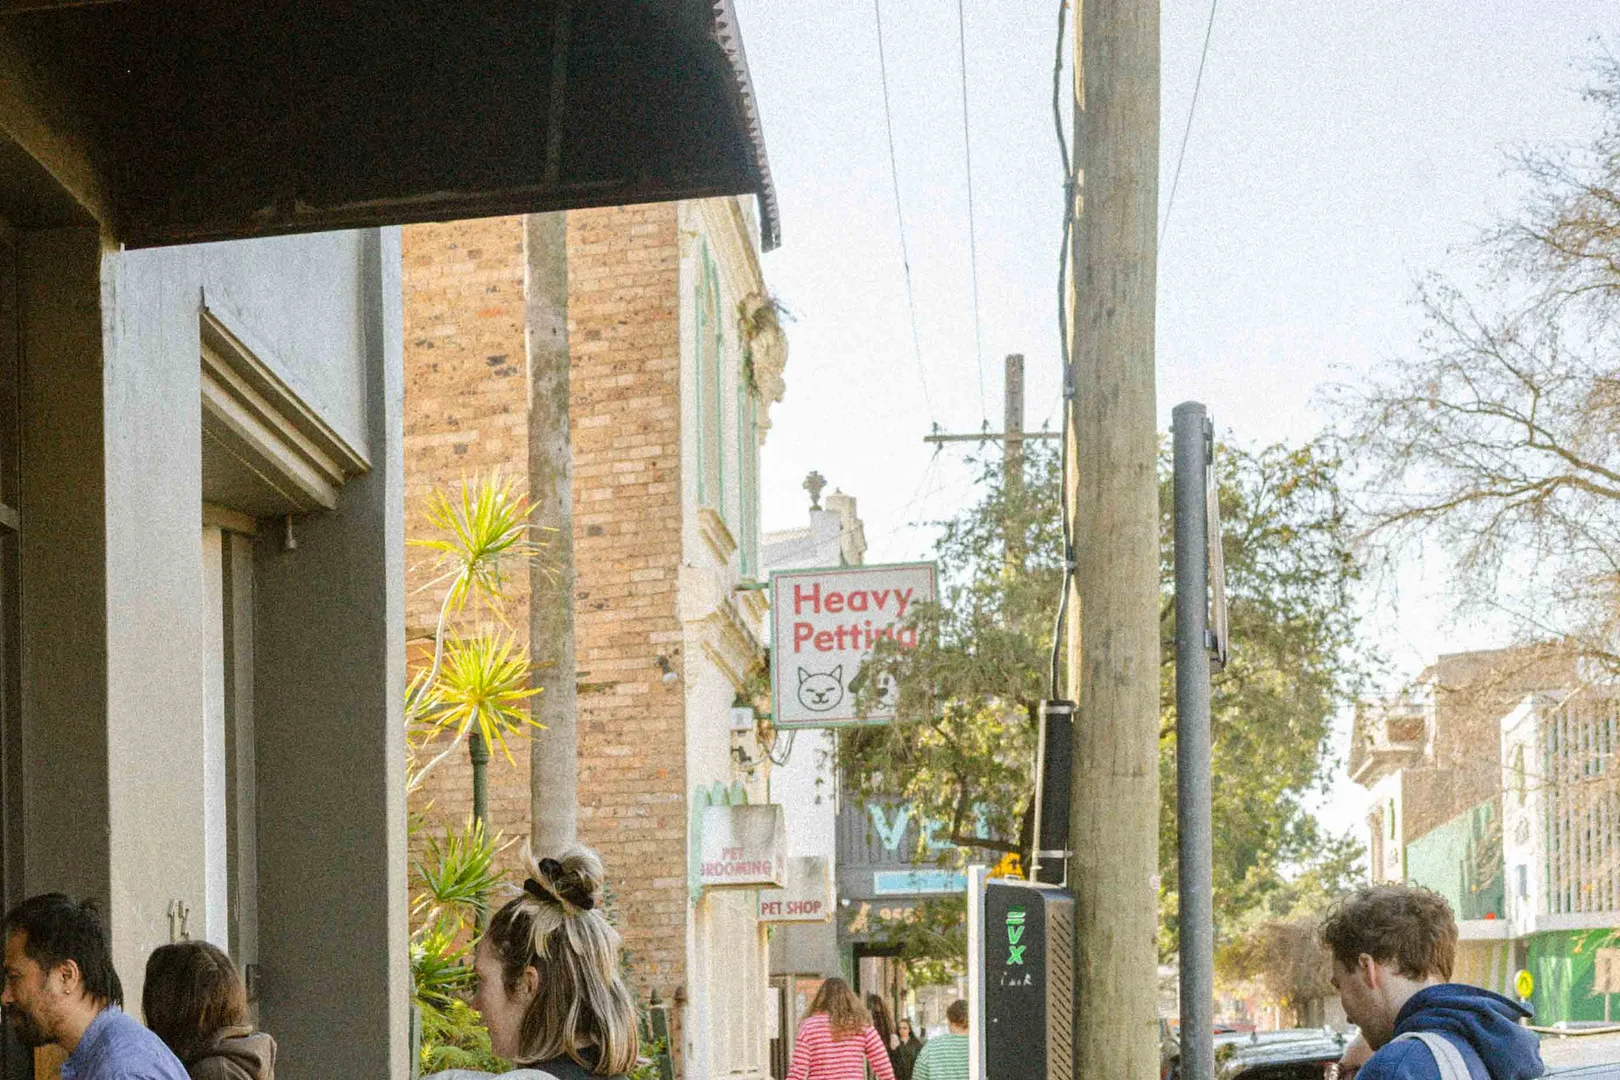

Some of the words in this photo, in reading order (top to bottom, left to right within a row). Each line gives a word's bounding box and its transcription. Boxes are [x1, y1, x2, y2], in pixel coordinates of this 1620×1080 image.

[793, 582, 914, 617] Heavy
[722, 847, 745, 860] PET
[761, 902, 783, 915] PET
[787, 900, 822, 914] SHOP
[1005, 905, 1027, 965] EVX
